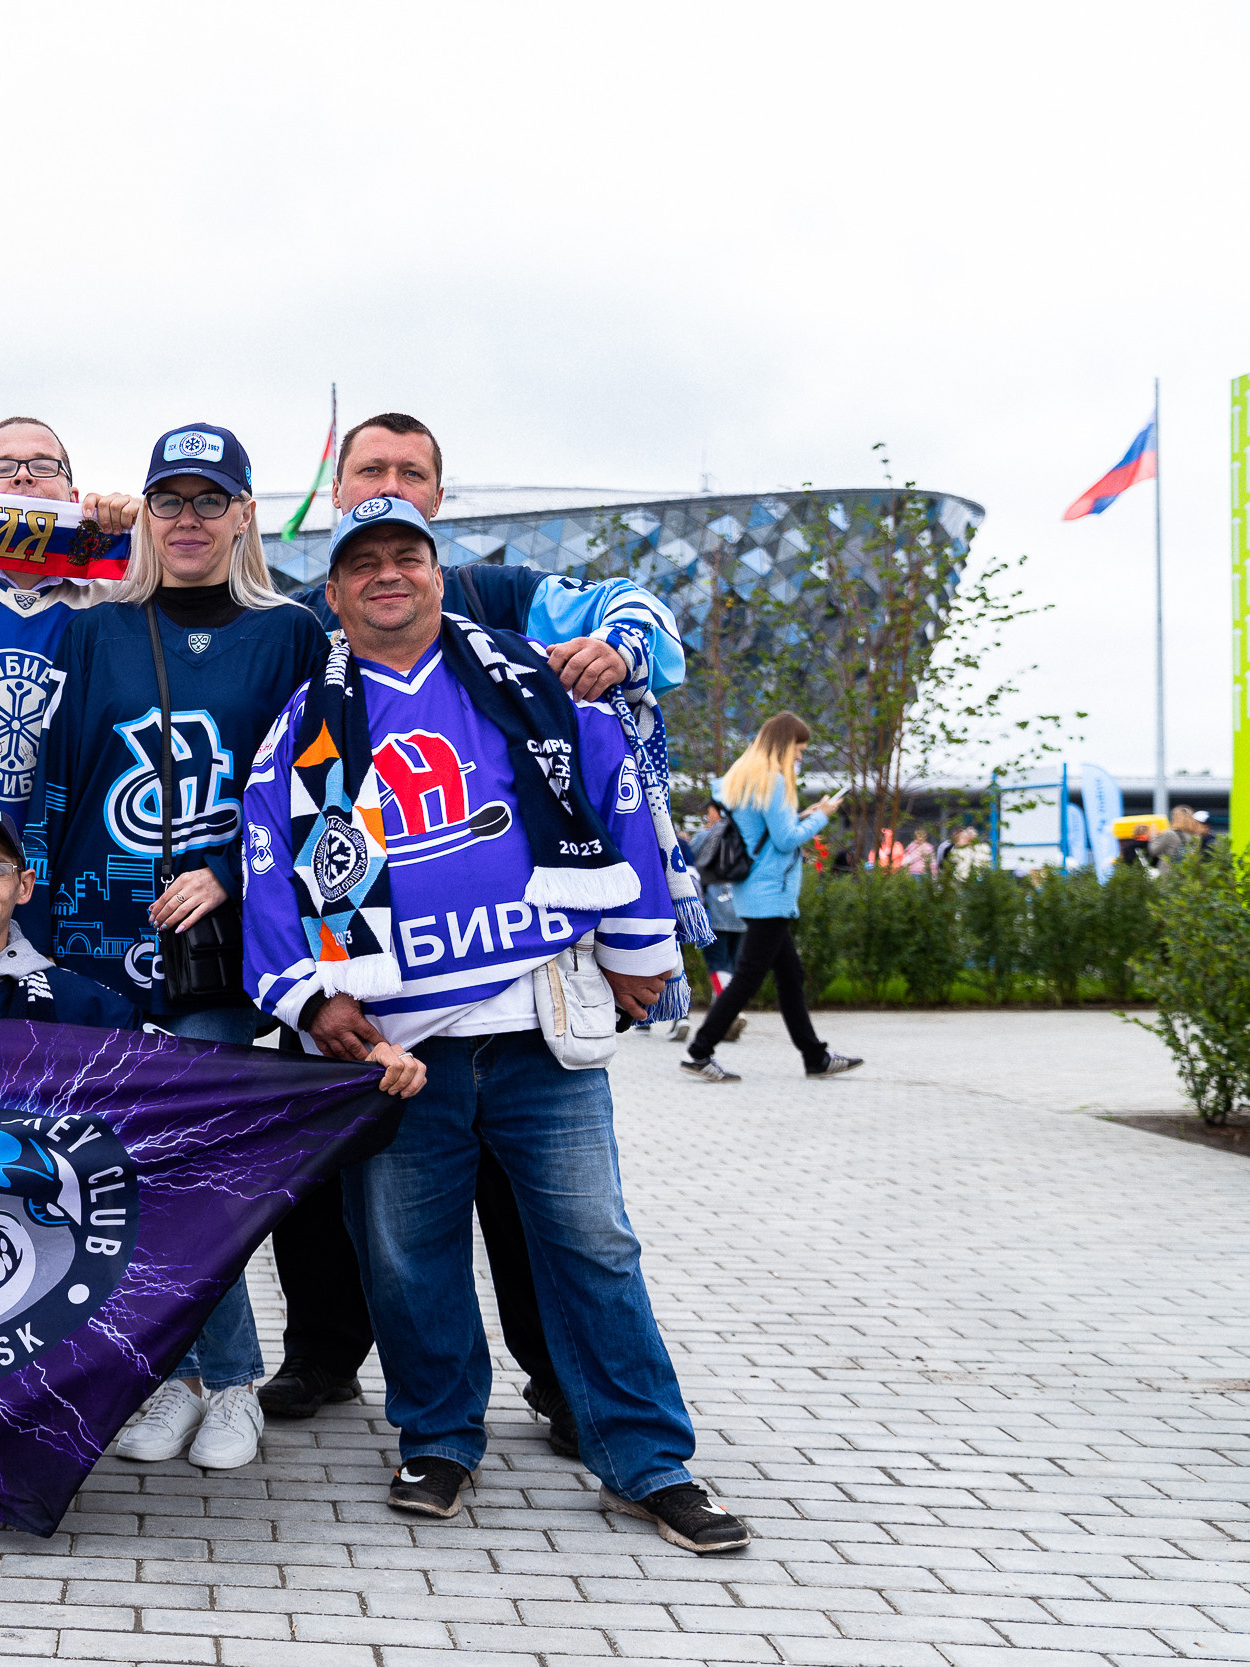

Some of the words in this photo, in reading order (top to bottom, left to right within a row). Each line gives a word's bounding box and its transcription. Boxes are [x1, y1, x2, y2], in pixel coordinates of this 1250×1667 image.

[559, 839, 603, 856] 2023
[398, 901, 574, 968] БИРЬ
[85, 1165, 127, 1256] CLUB
